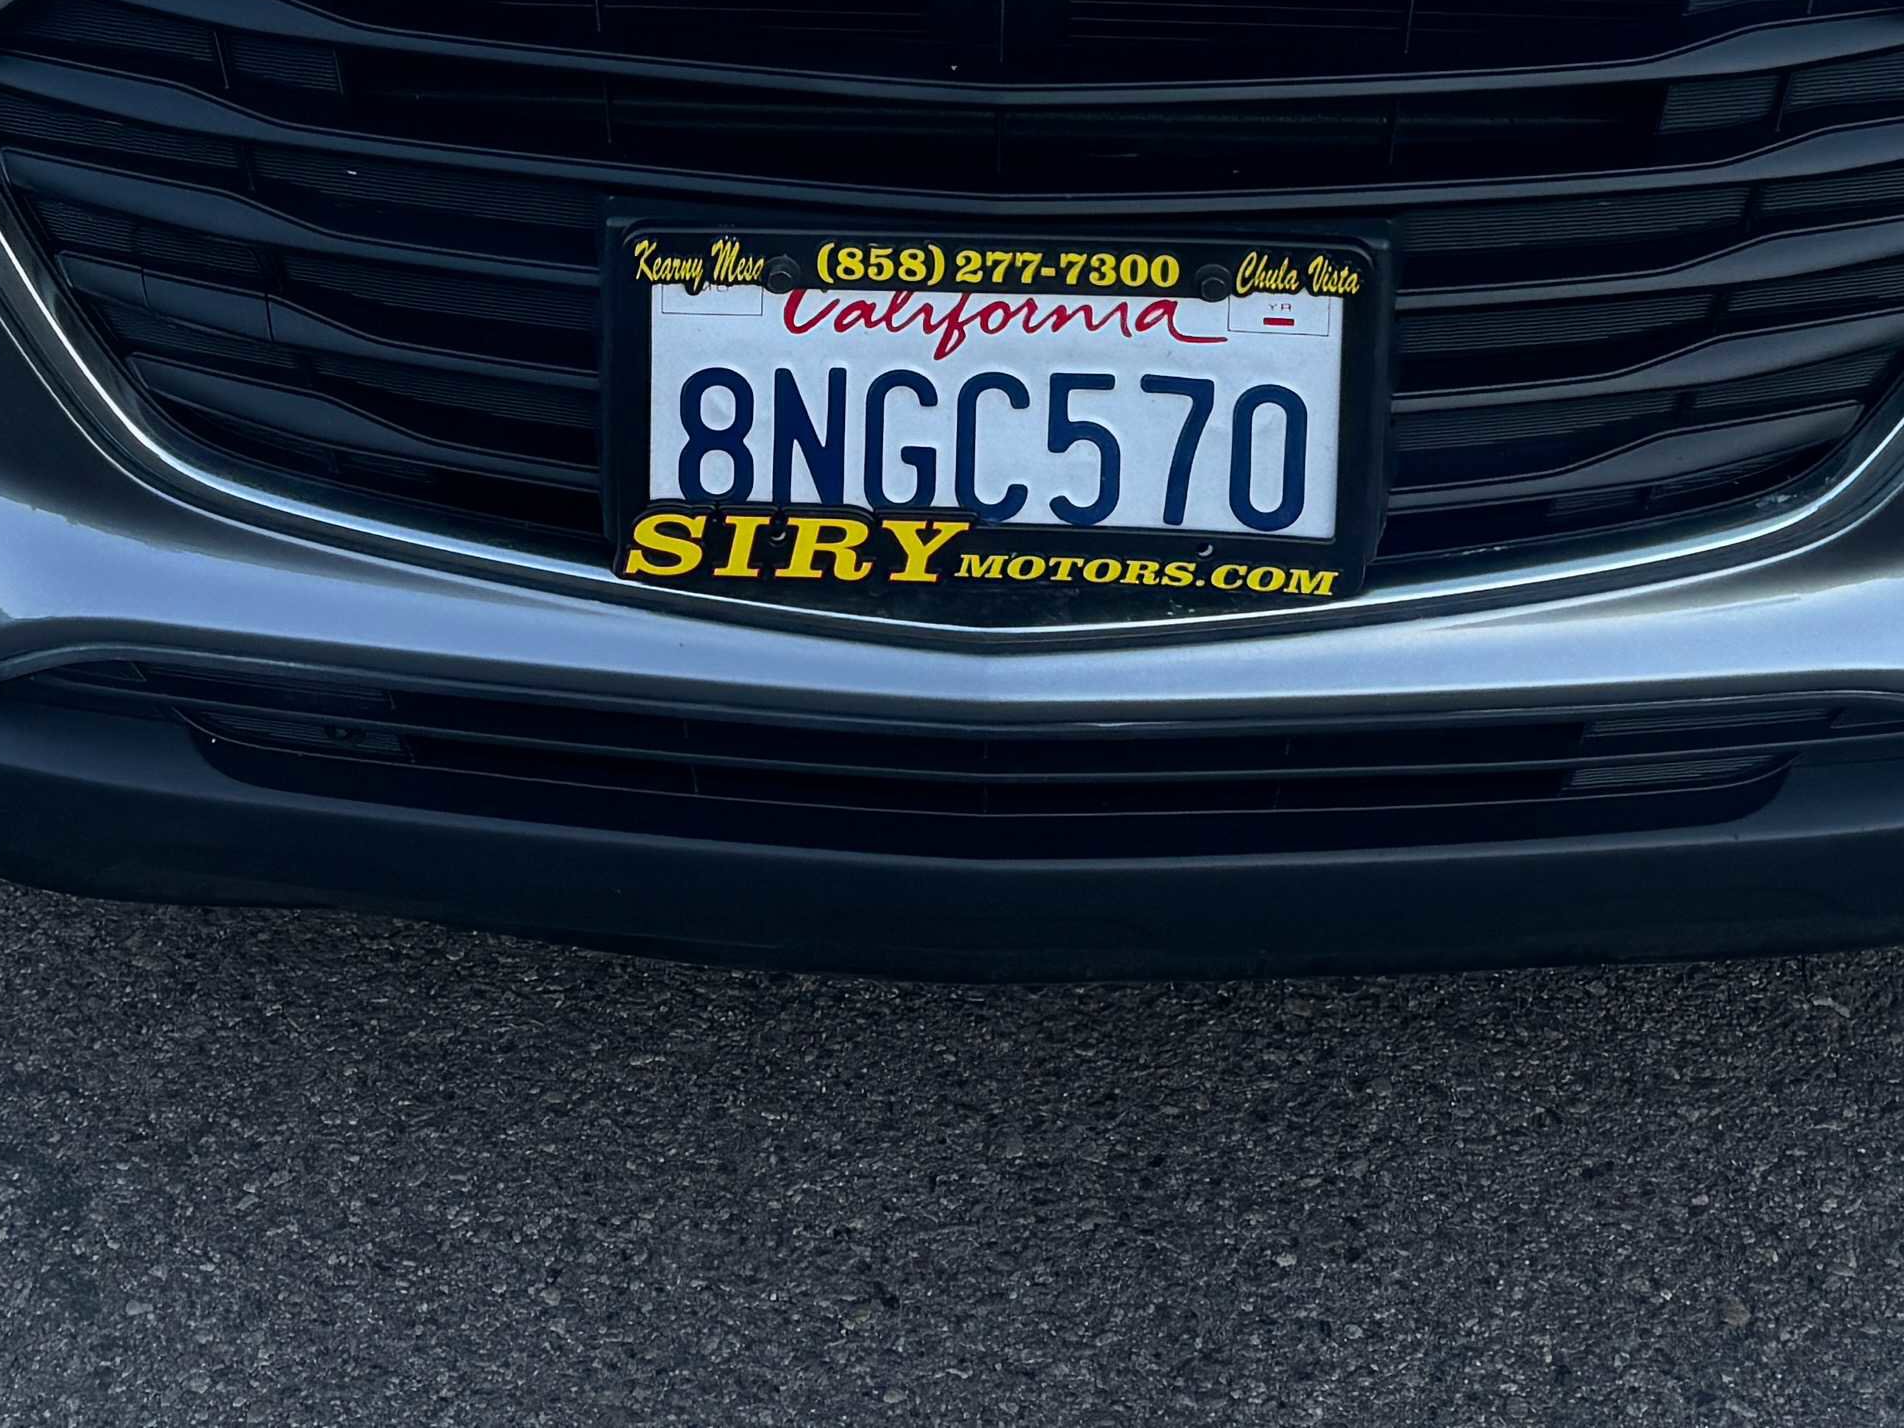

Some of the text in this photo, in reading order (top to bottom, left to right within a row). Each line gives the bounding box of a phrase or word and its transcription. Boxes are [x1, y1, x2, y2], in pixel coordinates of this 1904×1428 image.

[633, 238, 765, 292] Kearny Mesa
[816, 240, 1180, 289] (858) 277-7300
[1235, 250, 1360, 295] Chula Vista
[782, 288, 1228, 361] California
[1268, 303, 1292, 312] YR
[677, 366, 1309, 533] 8NGC570
[624, 514, 1340, 597] SIRY MOTORS.COM
